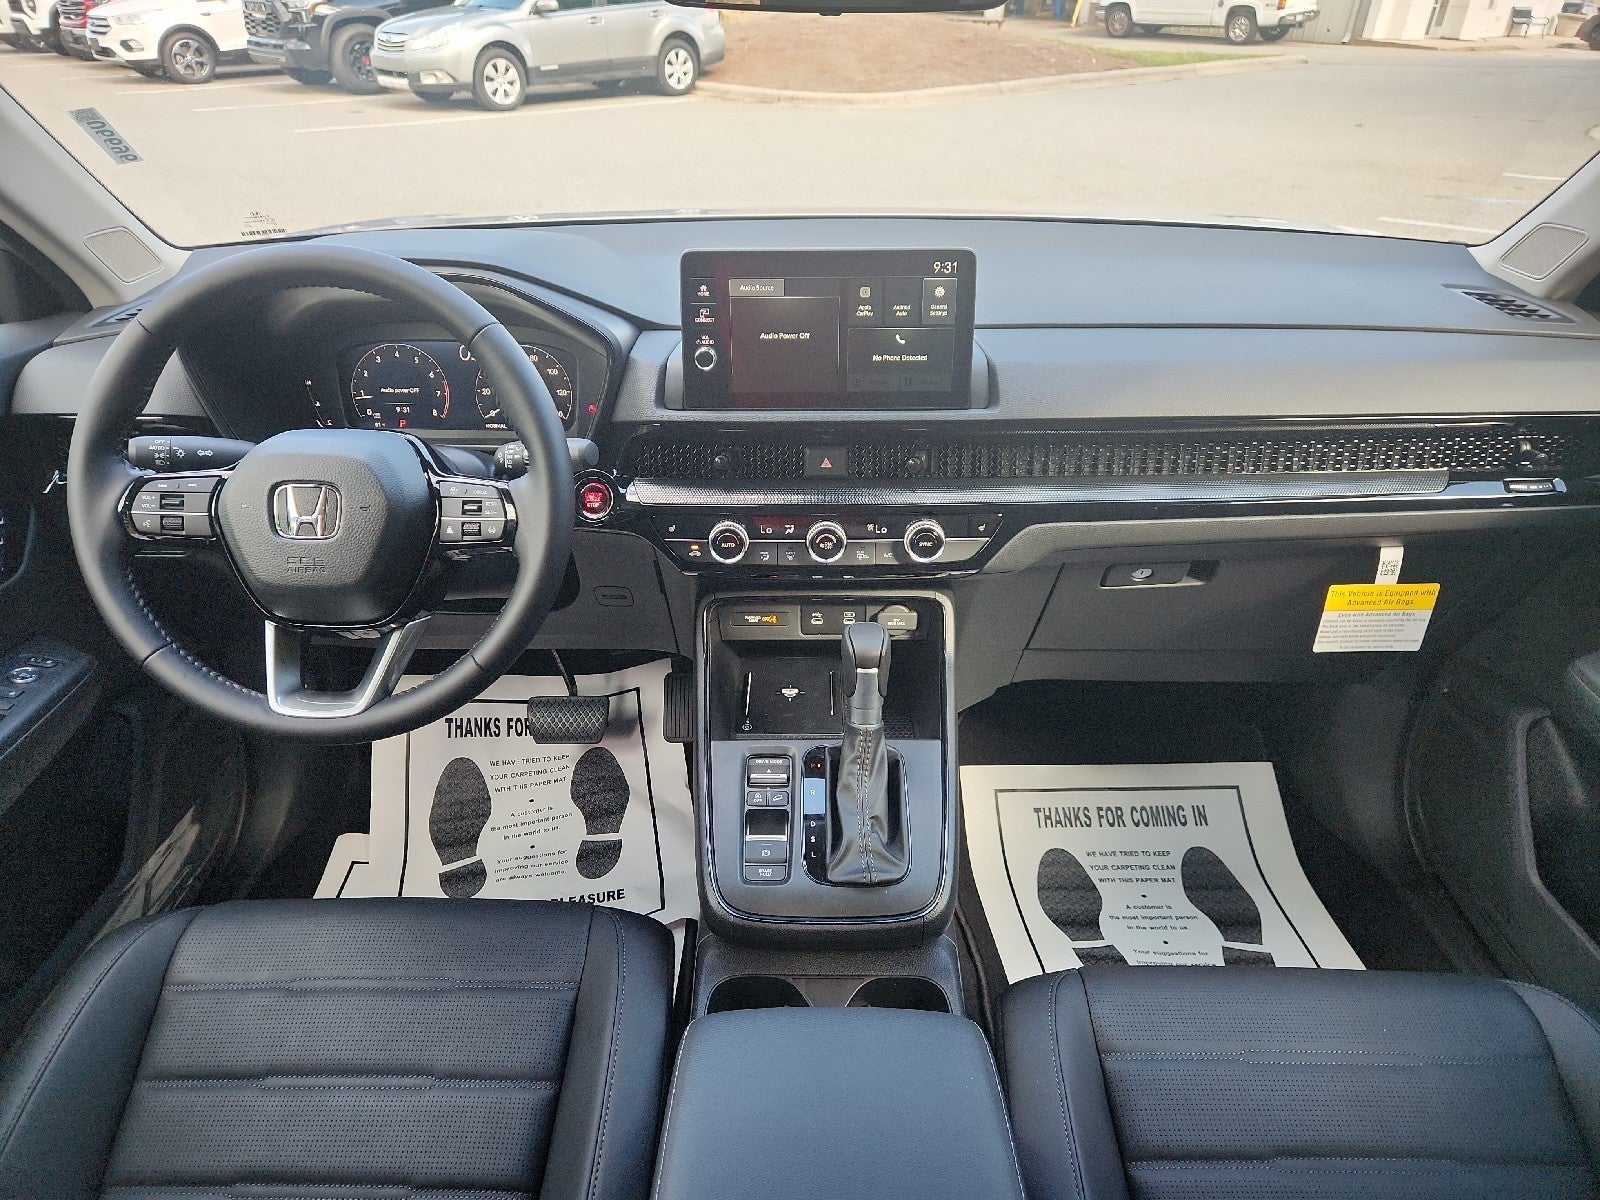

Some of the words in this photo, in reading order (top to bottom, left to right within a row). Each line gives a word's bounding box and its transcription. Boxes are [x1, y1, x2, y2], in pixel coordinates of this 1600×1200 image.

[933, 262, 958, 274] 9:31
[364, 369, 368, 378] 2
[428, 370, 434, 378] 6
[432, 408, 438, 416] 8
[400, 420, 406, 428] P
[760, 525, 772, 534] Lo
[876, 525, 888, 534] Lo
[444, 717, 500, 738] THANKS
[506, 718, 533, 737] FOR
[511, 768, 547, 778] CARPETING
[549, 764, 570, 773] CLEAN
[518, 807, 545, 816] customer
[521, 817, 550, 827] important
[552, 813, 572, 821] person
[1033, 806, 1092, 828] THANKS
[1096, 806, 1126, 828] FOR
[1130, 805, 1188, 827] COMING
[1191, 805, 1209, 826] IN
[515, 852, 556, 860] suggestions
[494, 864, 529, 873] improving
[551, 888, 626, 904] EASURE
